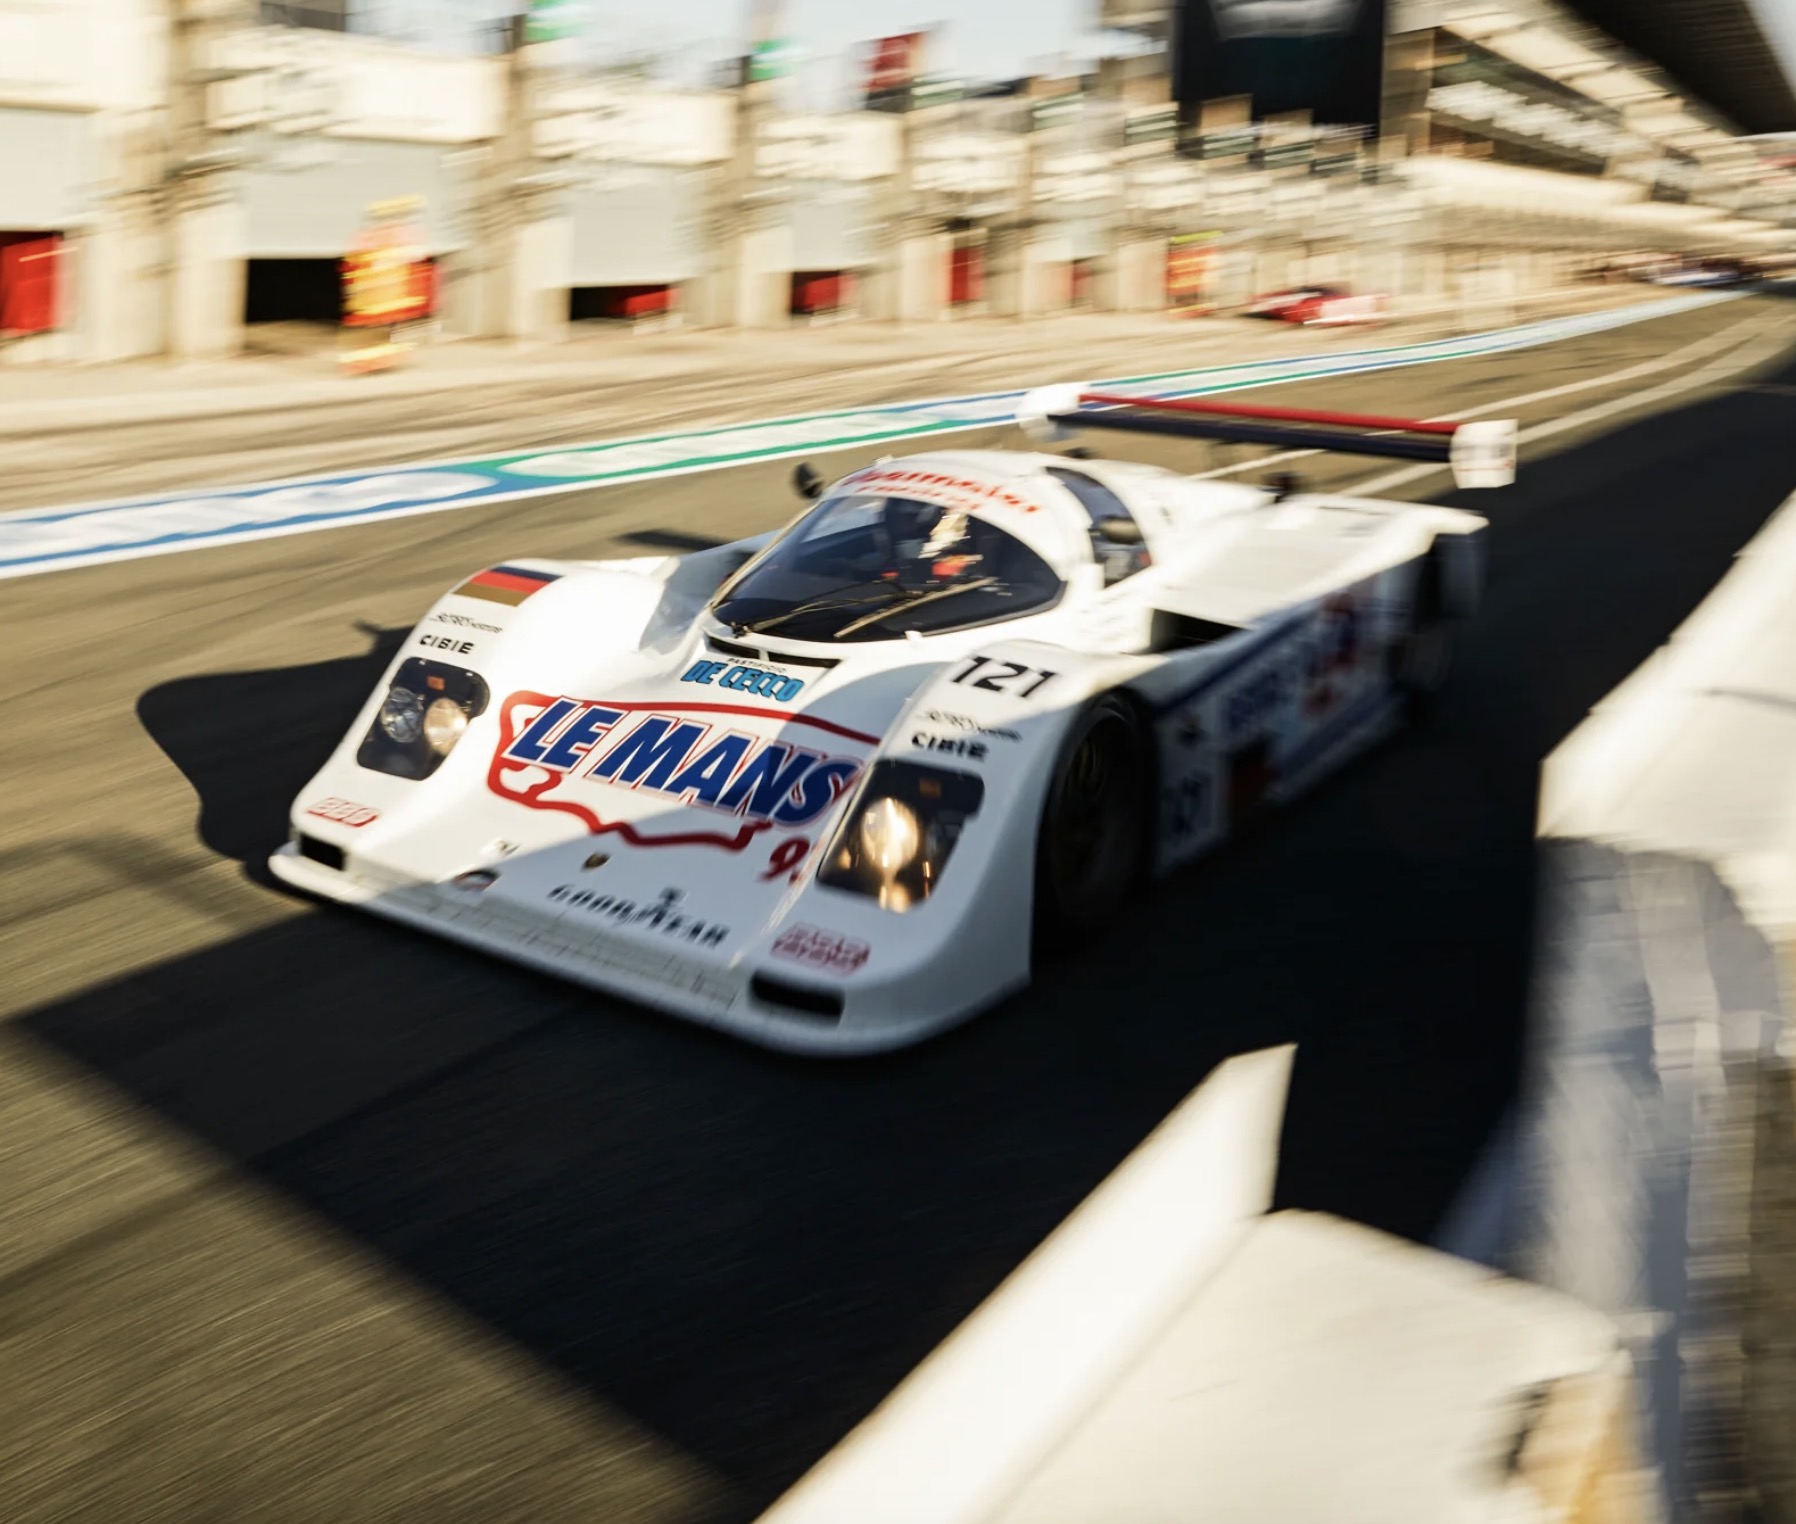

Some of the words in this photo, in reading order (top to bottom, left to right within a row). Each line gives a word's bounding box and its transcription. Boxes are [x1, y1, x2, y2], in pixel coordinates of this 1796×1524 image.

[419, 635, 475, 654] CIBIE
[680, 660, 729, 685] DE
[718, 665, 805, 702] CECCO
[951, 656, 1057, 698] 121
[501, 696, 631, 772] LE
[584, 713, 864, 829] MANS
